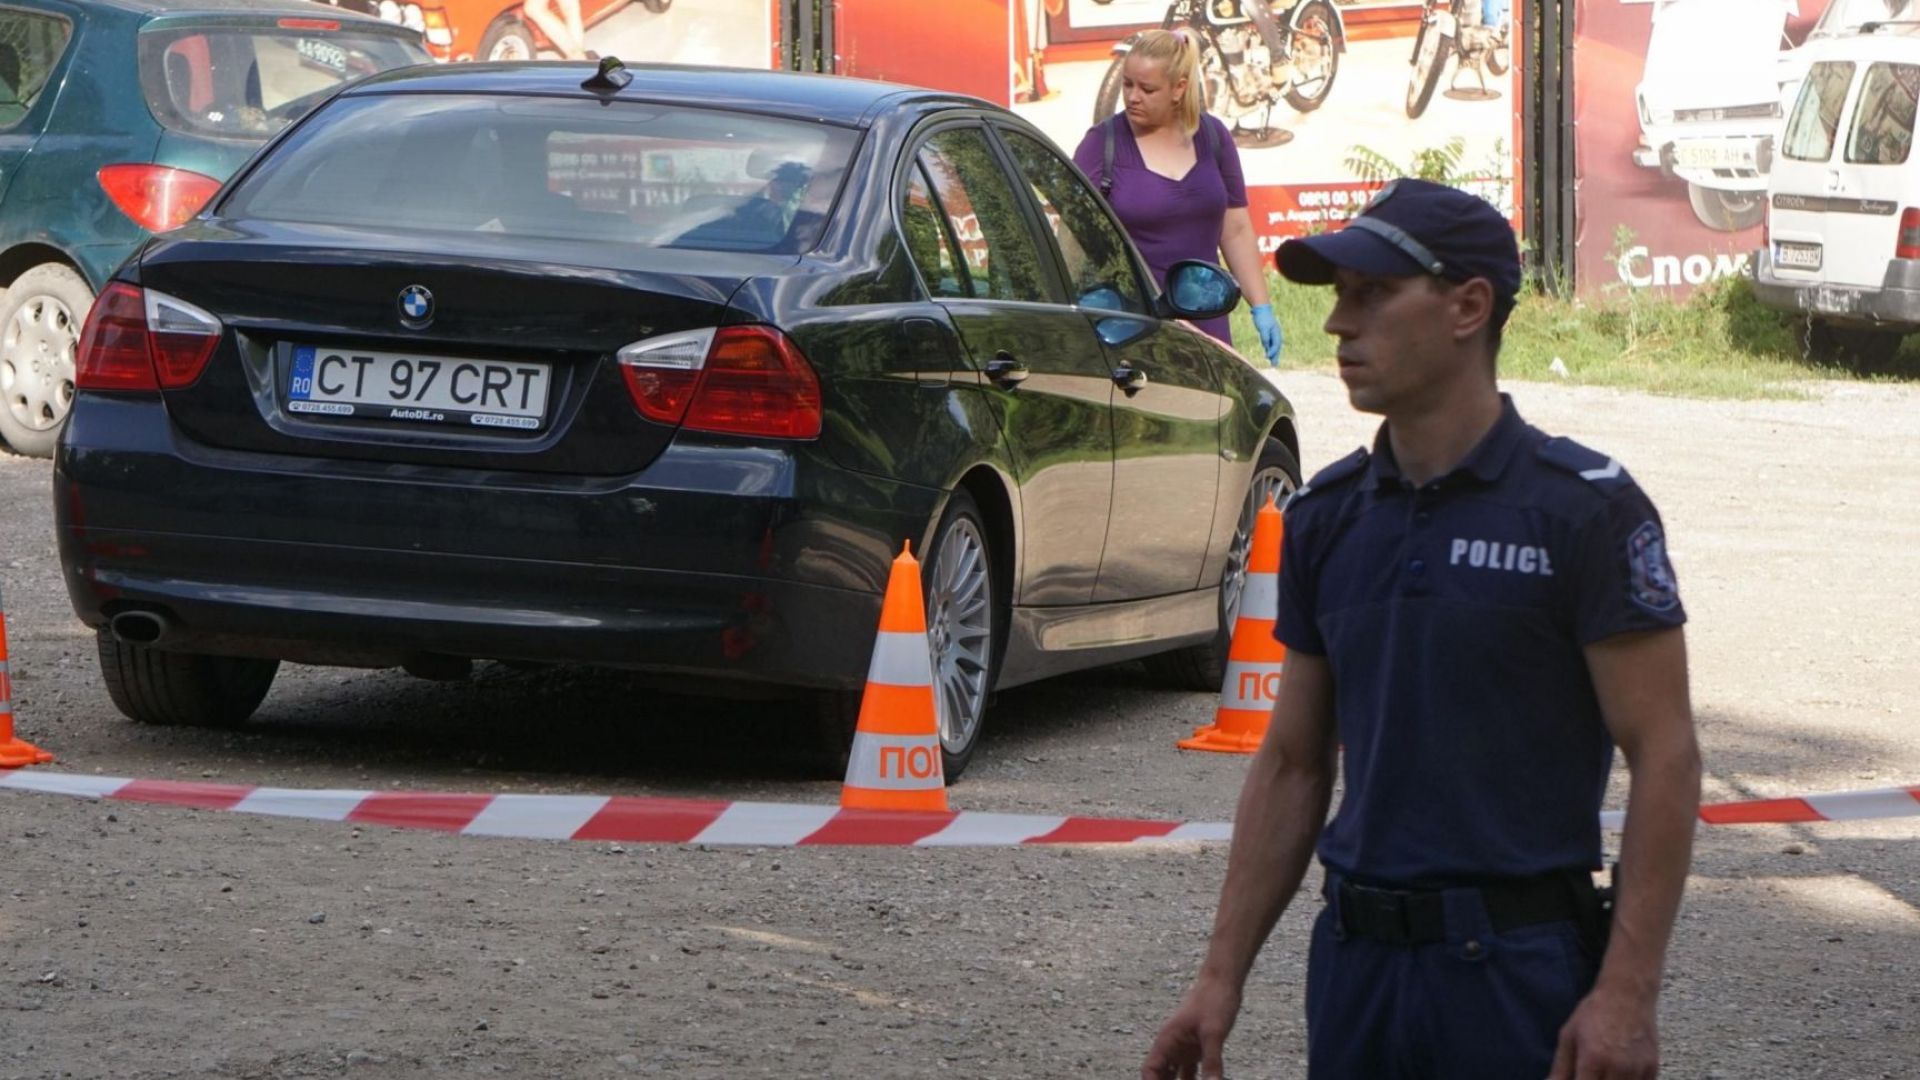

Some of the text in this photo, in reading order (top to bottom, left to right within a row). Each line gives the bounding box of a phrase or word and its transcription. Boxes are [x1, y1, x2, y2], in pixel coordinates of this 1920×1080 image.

[1618, 246, 1752, 287] Спом
[291, 355, 540, 409] RO CT 97 CRT
[390, 408, 445, 421] AutoDE.ro
[1238, 671, 1282, 702] ПО
